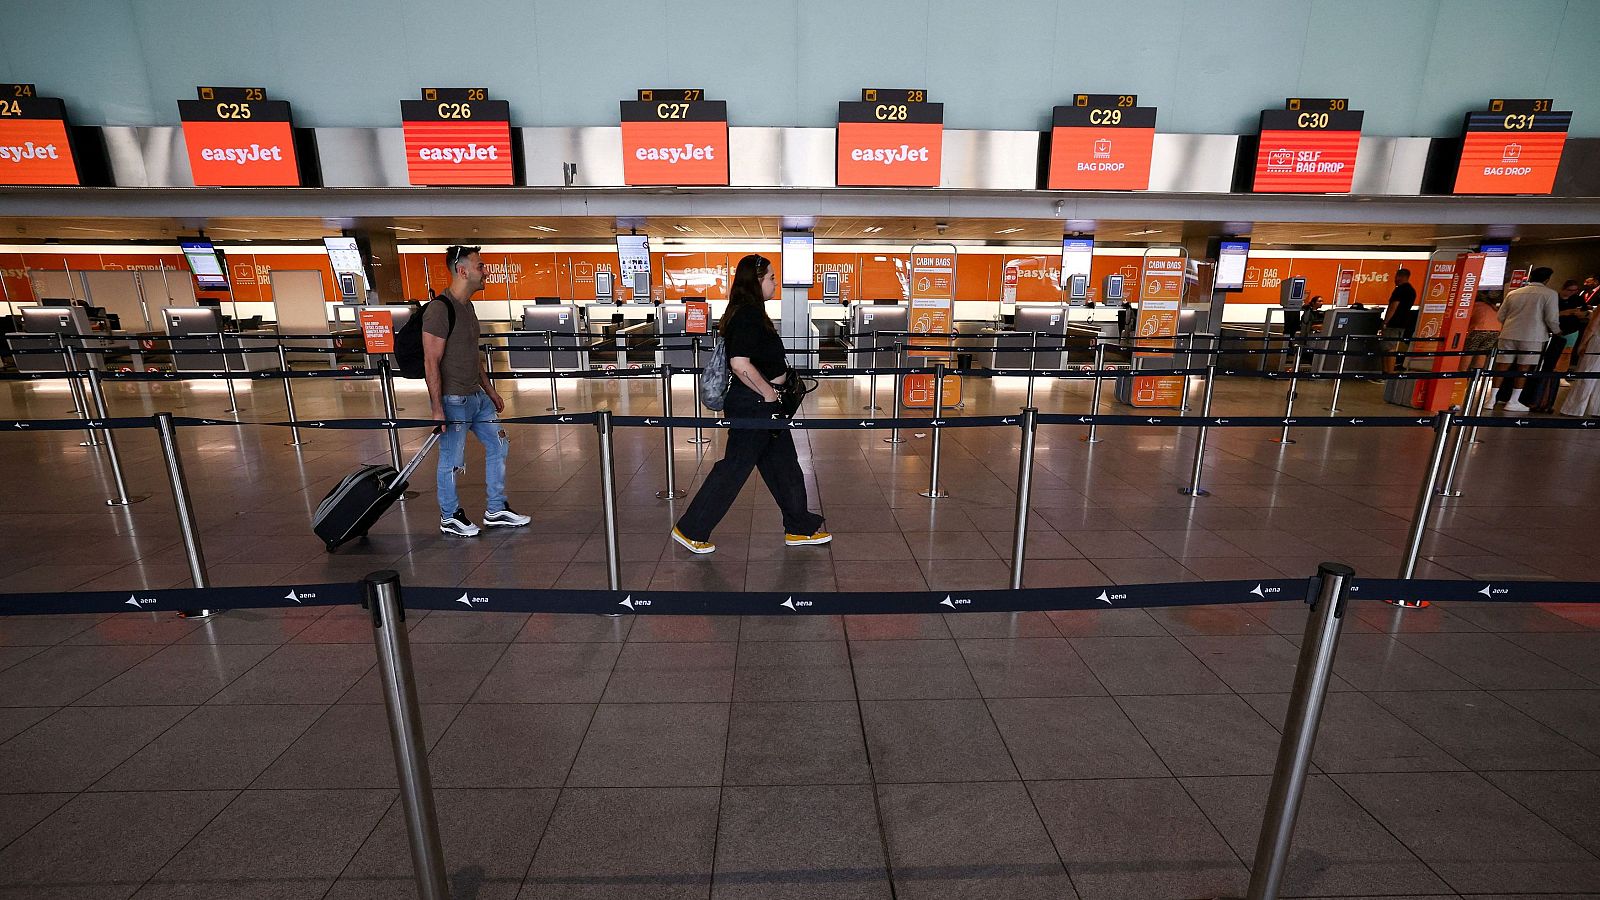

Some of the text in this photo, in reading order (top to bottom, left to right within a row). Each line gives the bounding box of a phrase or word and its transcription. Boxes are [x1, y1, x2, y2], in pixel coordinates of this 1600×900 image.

[15, 85, 31, 97] 24
[245, 88, 263, 101] 25
[468, 88, 484, 101] 26
[684, 89, 700, 101] 27
[907, 90, 923, 102] 28
[1118, 96, 1134, 107] 29
[1329, 99, 1345, 111] 30
[1533, 100, 1548, 112] 31
[216, 103, 251, 119] C25
[437, 103, 471, 119] C26
[656, 103, 690, 119] C27
[875, 104, 908, 121] C28
[1089, 109, 1122, 125] C29
[1297, 112, 1329, 128] C30
[1503, 114, 1535, 130] C31
[201, 143, 282, 164] easyJet
[418, 143, 498, 164] easyJet
[635, 143, 715, 164] easyJet
[851, 144, 929, 165] easyJet
[1297, 150, 1321, 162] SELF
[1077, 162, 1125, 172] BAG DROP
[1296, 162, 1345, 173] BAG DROP
[1483, 166, 1532, 176] BAG DROP
[916, 258, 951, 266] CABIN BAGS
[1148, 261, 1182, 270] CABIN BAGS
[1434, 264, 1453, 272] CABIN
[1263, 268, 1278, 278] BAG
[1261, 278, 1281, 288] DROP
[1463, 272, 1477, 292] DROP
[1459, 292, 1473, 307] BAG
[1110, 592, 1127, 600] aena
